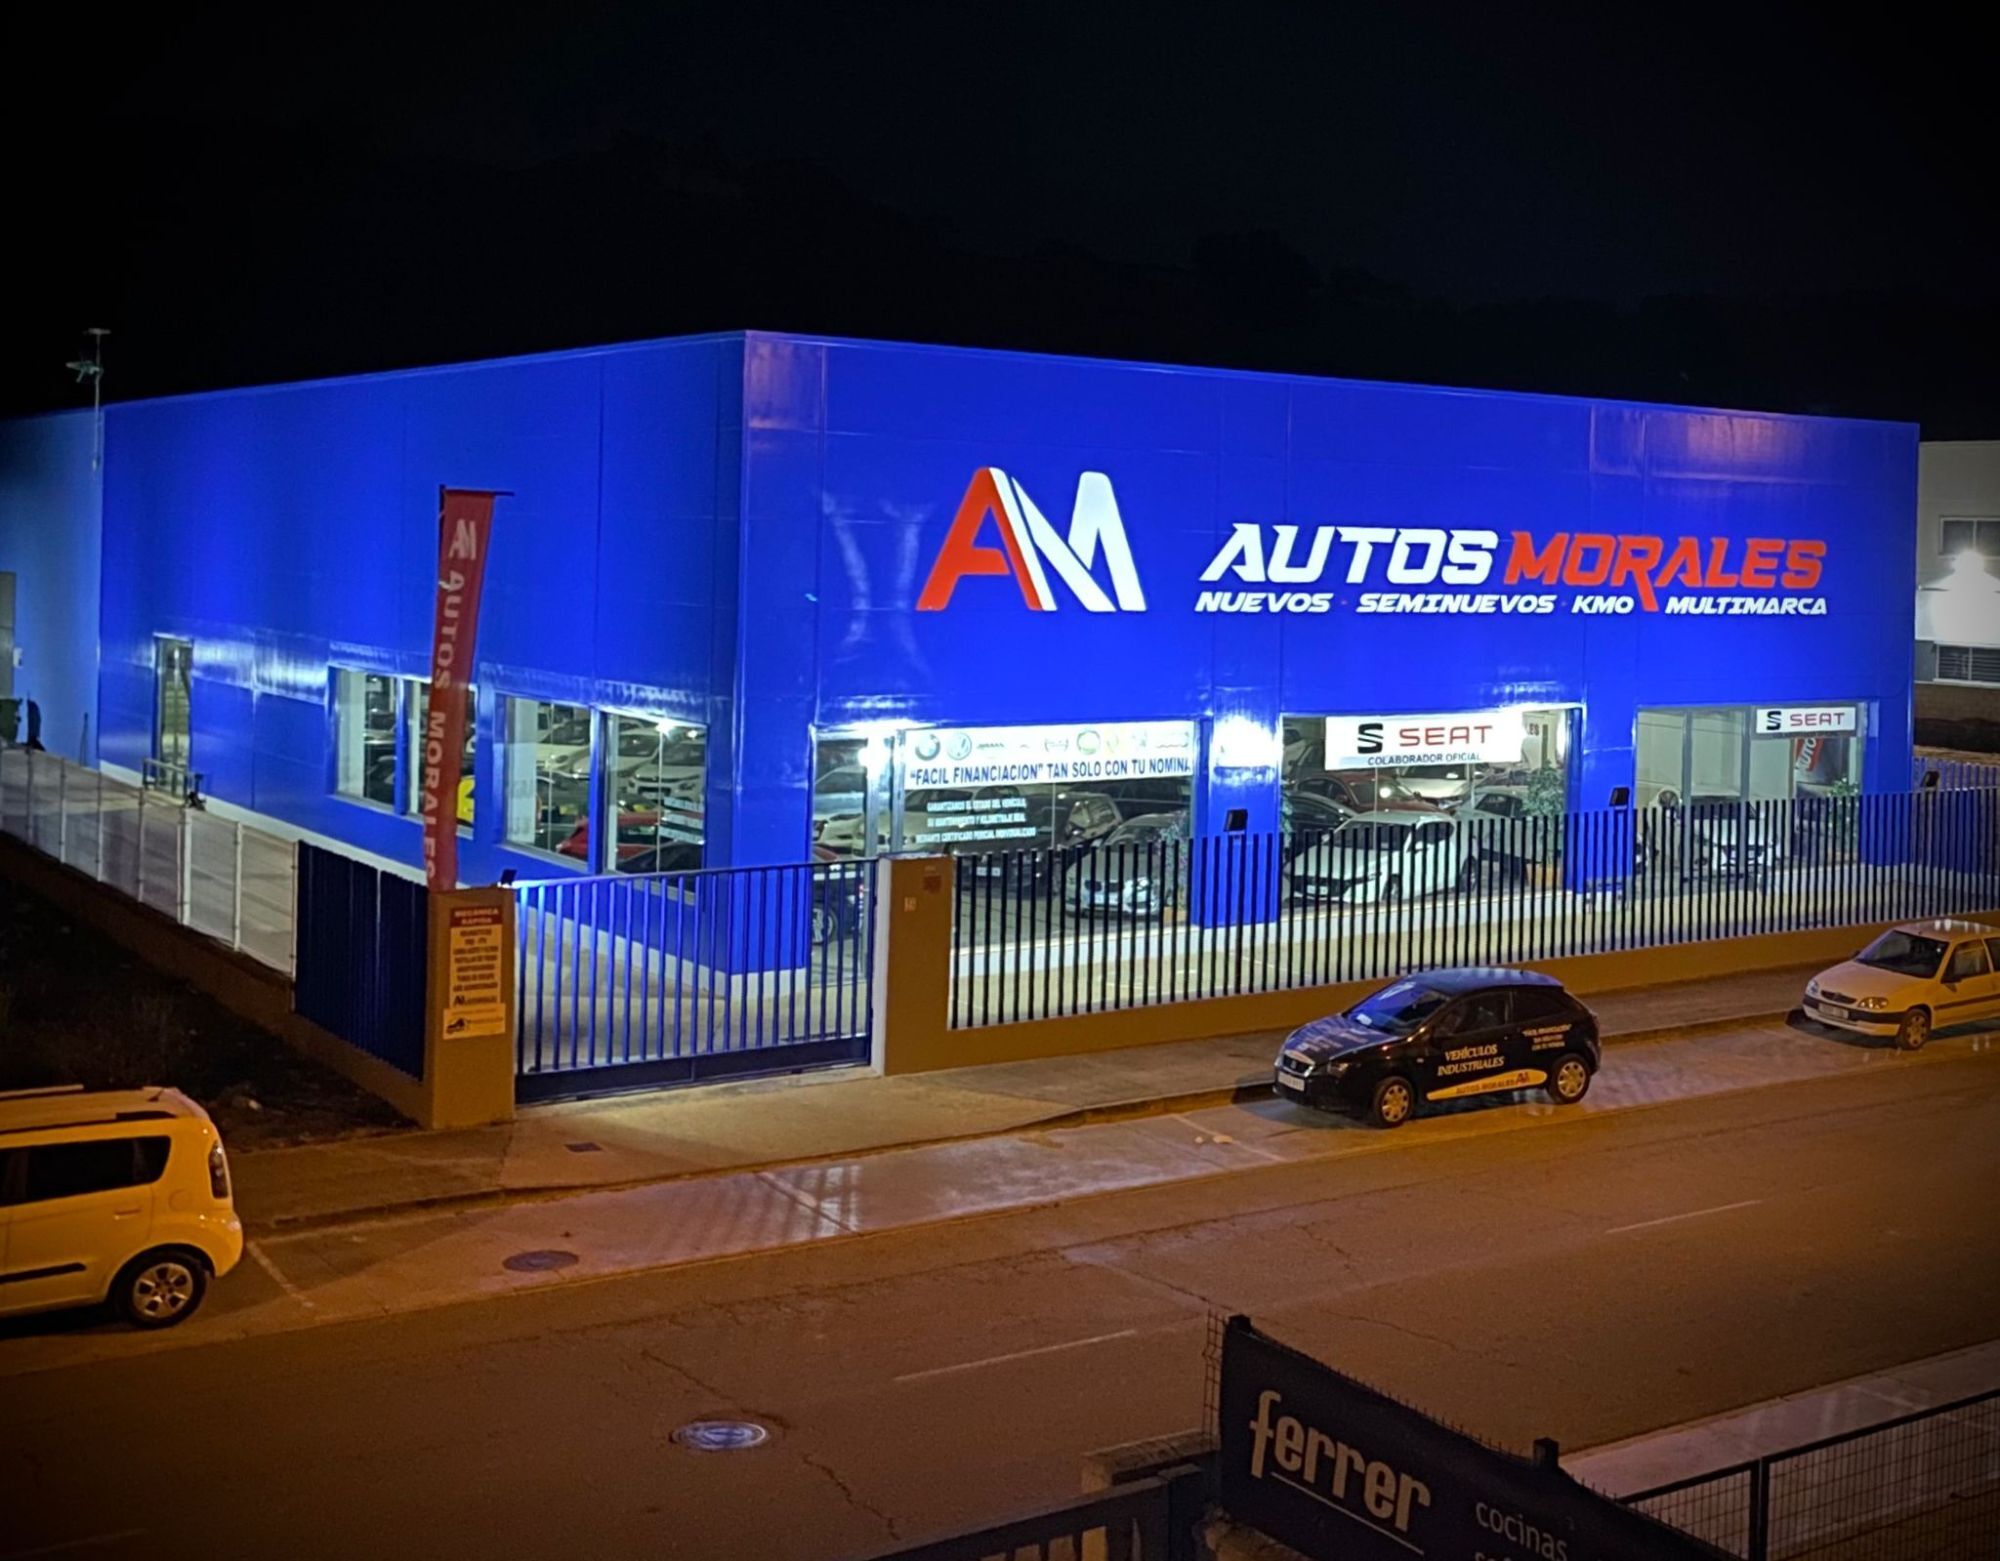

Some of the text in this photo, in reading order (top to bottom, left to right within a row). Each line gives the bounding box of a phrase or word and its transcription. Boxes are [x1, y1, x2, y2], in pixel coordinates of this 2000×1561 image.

[915, 466, 1147, 612] AM
[1199, 523, 1826, 612] AUTOS MORALES
[1194, 591, 1334, 613] NUEVOS
[1356, 593, 1557, 614] SEMINUEVOS
[1665, 596, 1828, 615] MULTIMARCA
[434, 569, 465, 689] AUTOS
[1790, 712, 1846, 727] SEAT
[1399, 725, 1493, 747] SEAT
[1046, 762, 1068, 778] TAN
[1072, 760, 1101, 778] SOLO
[1105, 758, 1128, 776] CON
[1131, 758, 1145, 774] TU
[1367, 751, 1482, 766] COLABORADOR OFICIAL
[1445, 1043, 1498, 1062] VEHÍCULOS
[1437, 1056, 1505, 1077] INDUSTRIALES
[1250, 1390, 1432, 1532] ferrer
[1475, 1501, 1568, 1561] cocinas
